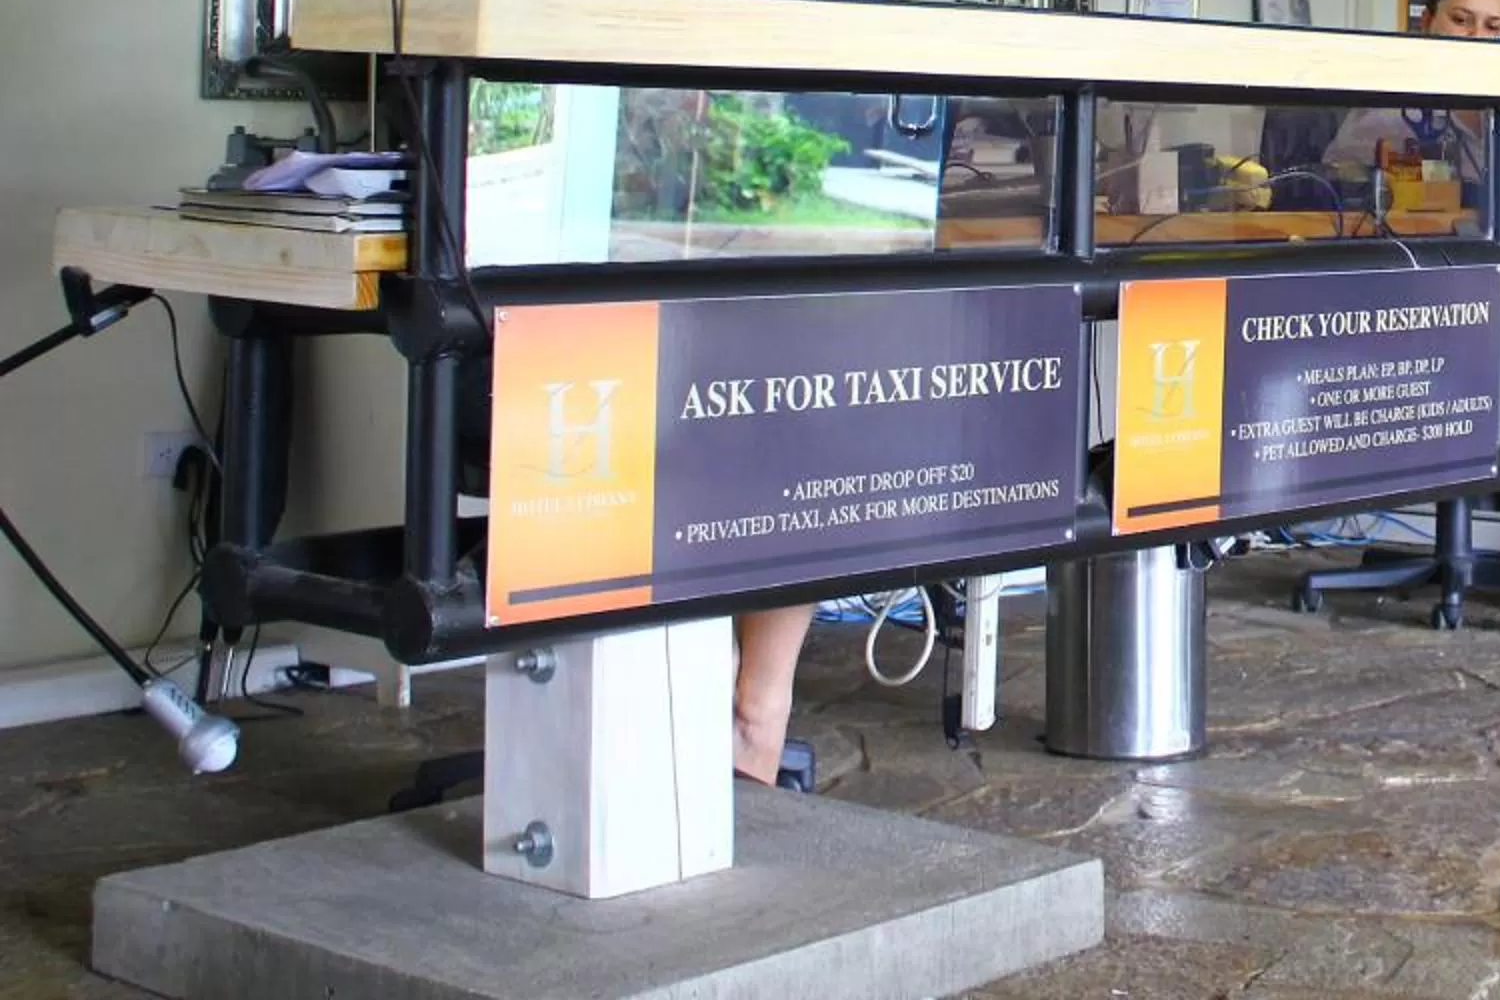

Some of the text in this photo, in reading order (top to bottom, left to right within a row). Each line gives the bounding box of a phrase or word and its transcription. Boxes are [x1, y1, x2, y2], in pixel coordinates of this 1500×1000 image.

[1242, 301, 1489, 343] CHECK YOUR RESERVATION
[680, 356, 1063, 420] ASK FOR TAXI SERVICE
[1304, 367, 1345, 385] MEALS
[1318, 380, 1431, 406] ONE OR MORE GUEST
[1239, 421, 1280, 441] EXTRA
[1281, 416, 1321, 435] GUEST
[1323, 411, 1352, 429] WILL
[1354, 410, 1369, 427] BE
[1371, 404, 1416, 425] CHARGE
[1262, 443, 1285, 461] PET
[1286, 437, 1345, 459] ALLOWED
[1345, 433, 1371, 451] AND
[1445, 419, 1473, 437] HOLD
[793, 461, 975, 500] AIRPORT DROP OFF $20
[687, 514, 775, 544] PRIVATED
[827, 503, 862, 527] ASK
[865, 499, 898, 521] FOR
[901, 493, 949, 517] MORE
[953, 479, 1060, 510] DESTINATIONS
